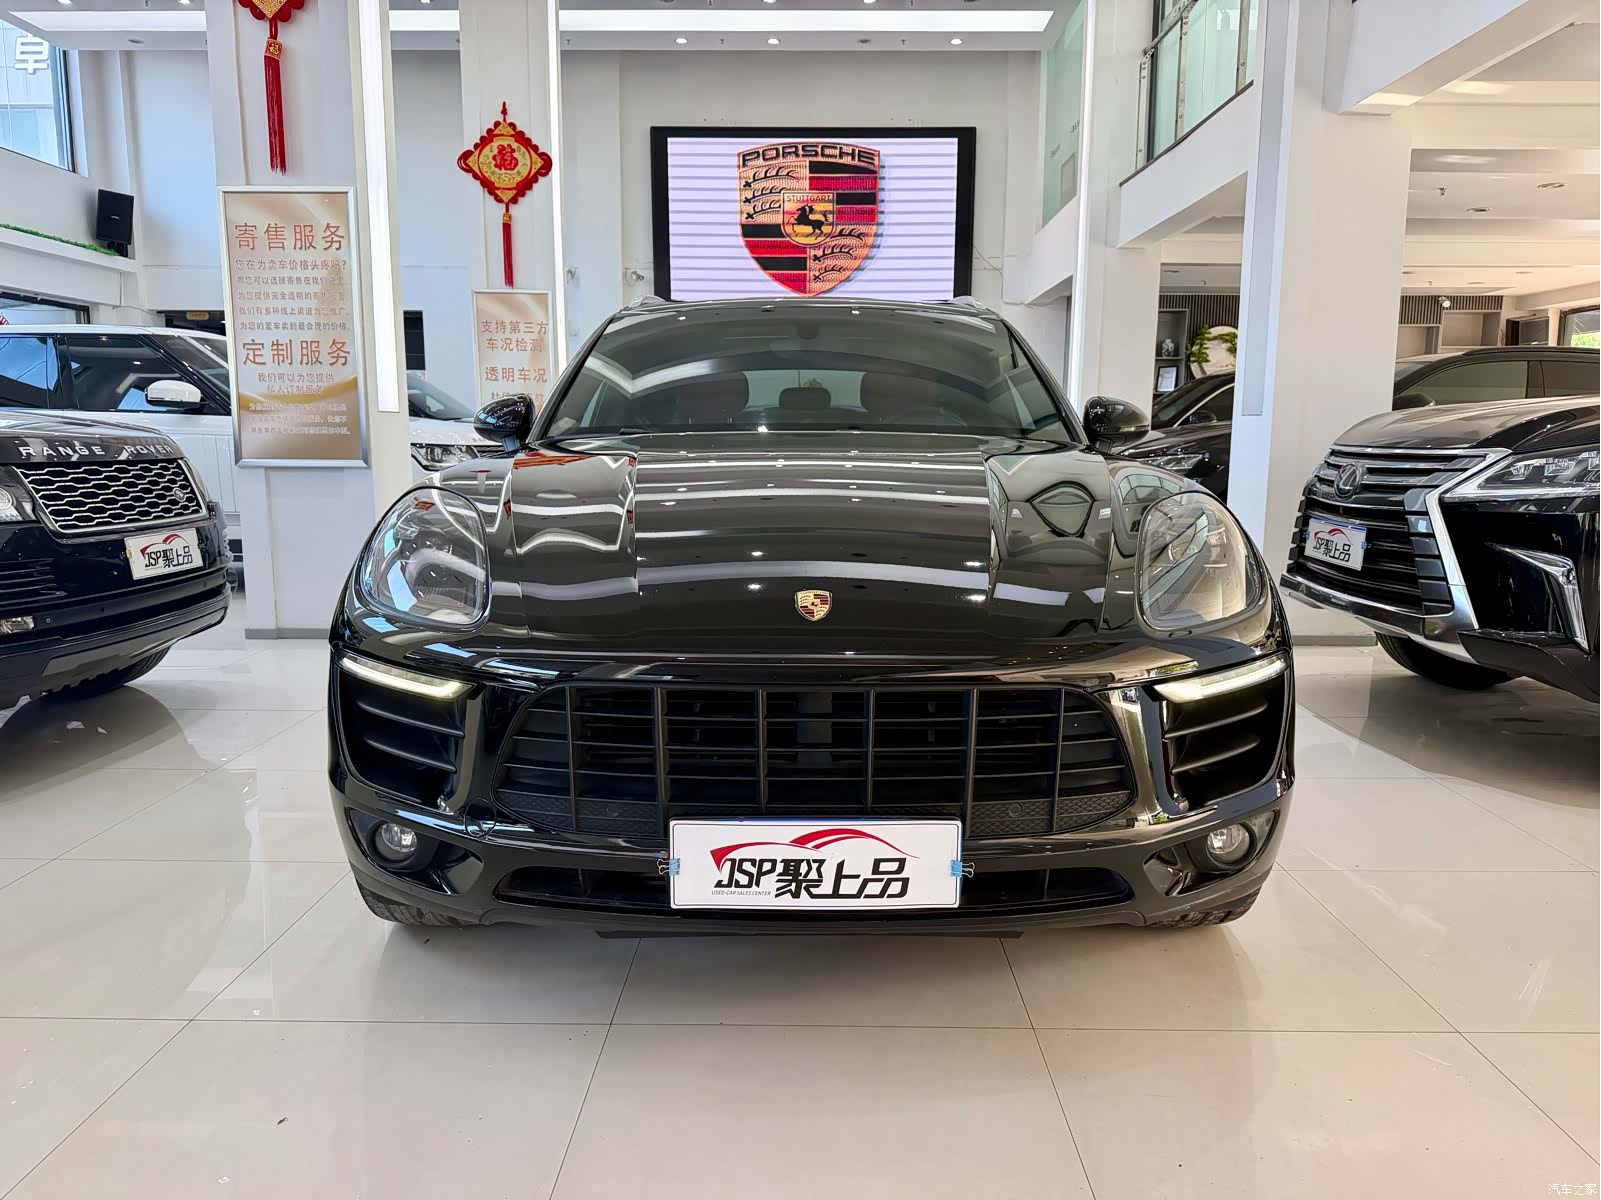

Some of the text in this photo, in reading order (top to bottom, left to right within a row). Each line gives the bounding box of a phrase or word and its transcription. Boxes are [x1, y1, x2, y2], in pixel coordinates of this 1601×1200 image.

[492, 144, 519, 171] 福
[741, 144, 876, 168] PORSCHE
[786, 194, 832, 203] STUTTGART
[234, 222, 345, 251] 寄售服务
[235, 259, 347, 271] 您在为卖车价格头疼吗？
[481, 320, 549, 336] 支持第三方
[242, 338, 351, 366] 定制服务
[486, 337, 545, 353] 车况检测
[257, 372, 335, 383] 我们可以为您提供
[485, 366, 548, 383] 透明车况
[17, 444, 174, 457] RANGE ROVER
